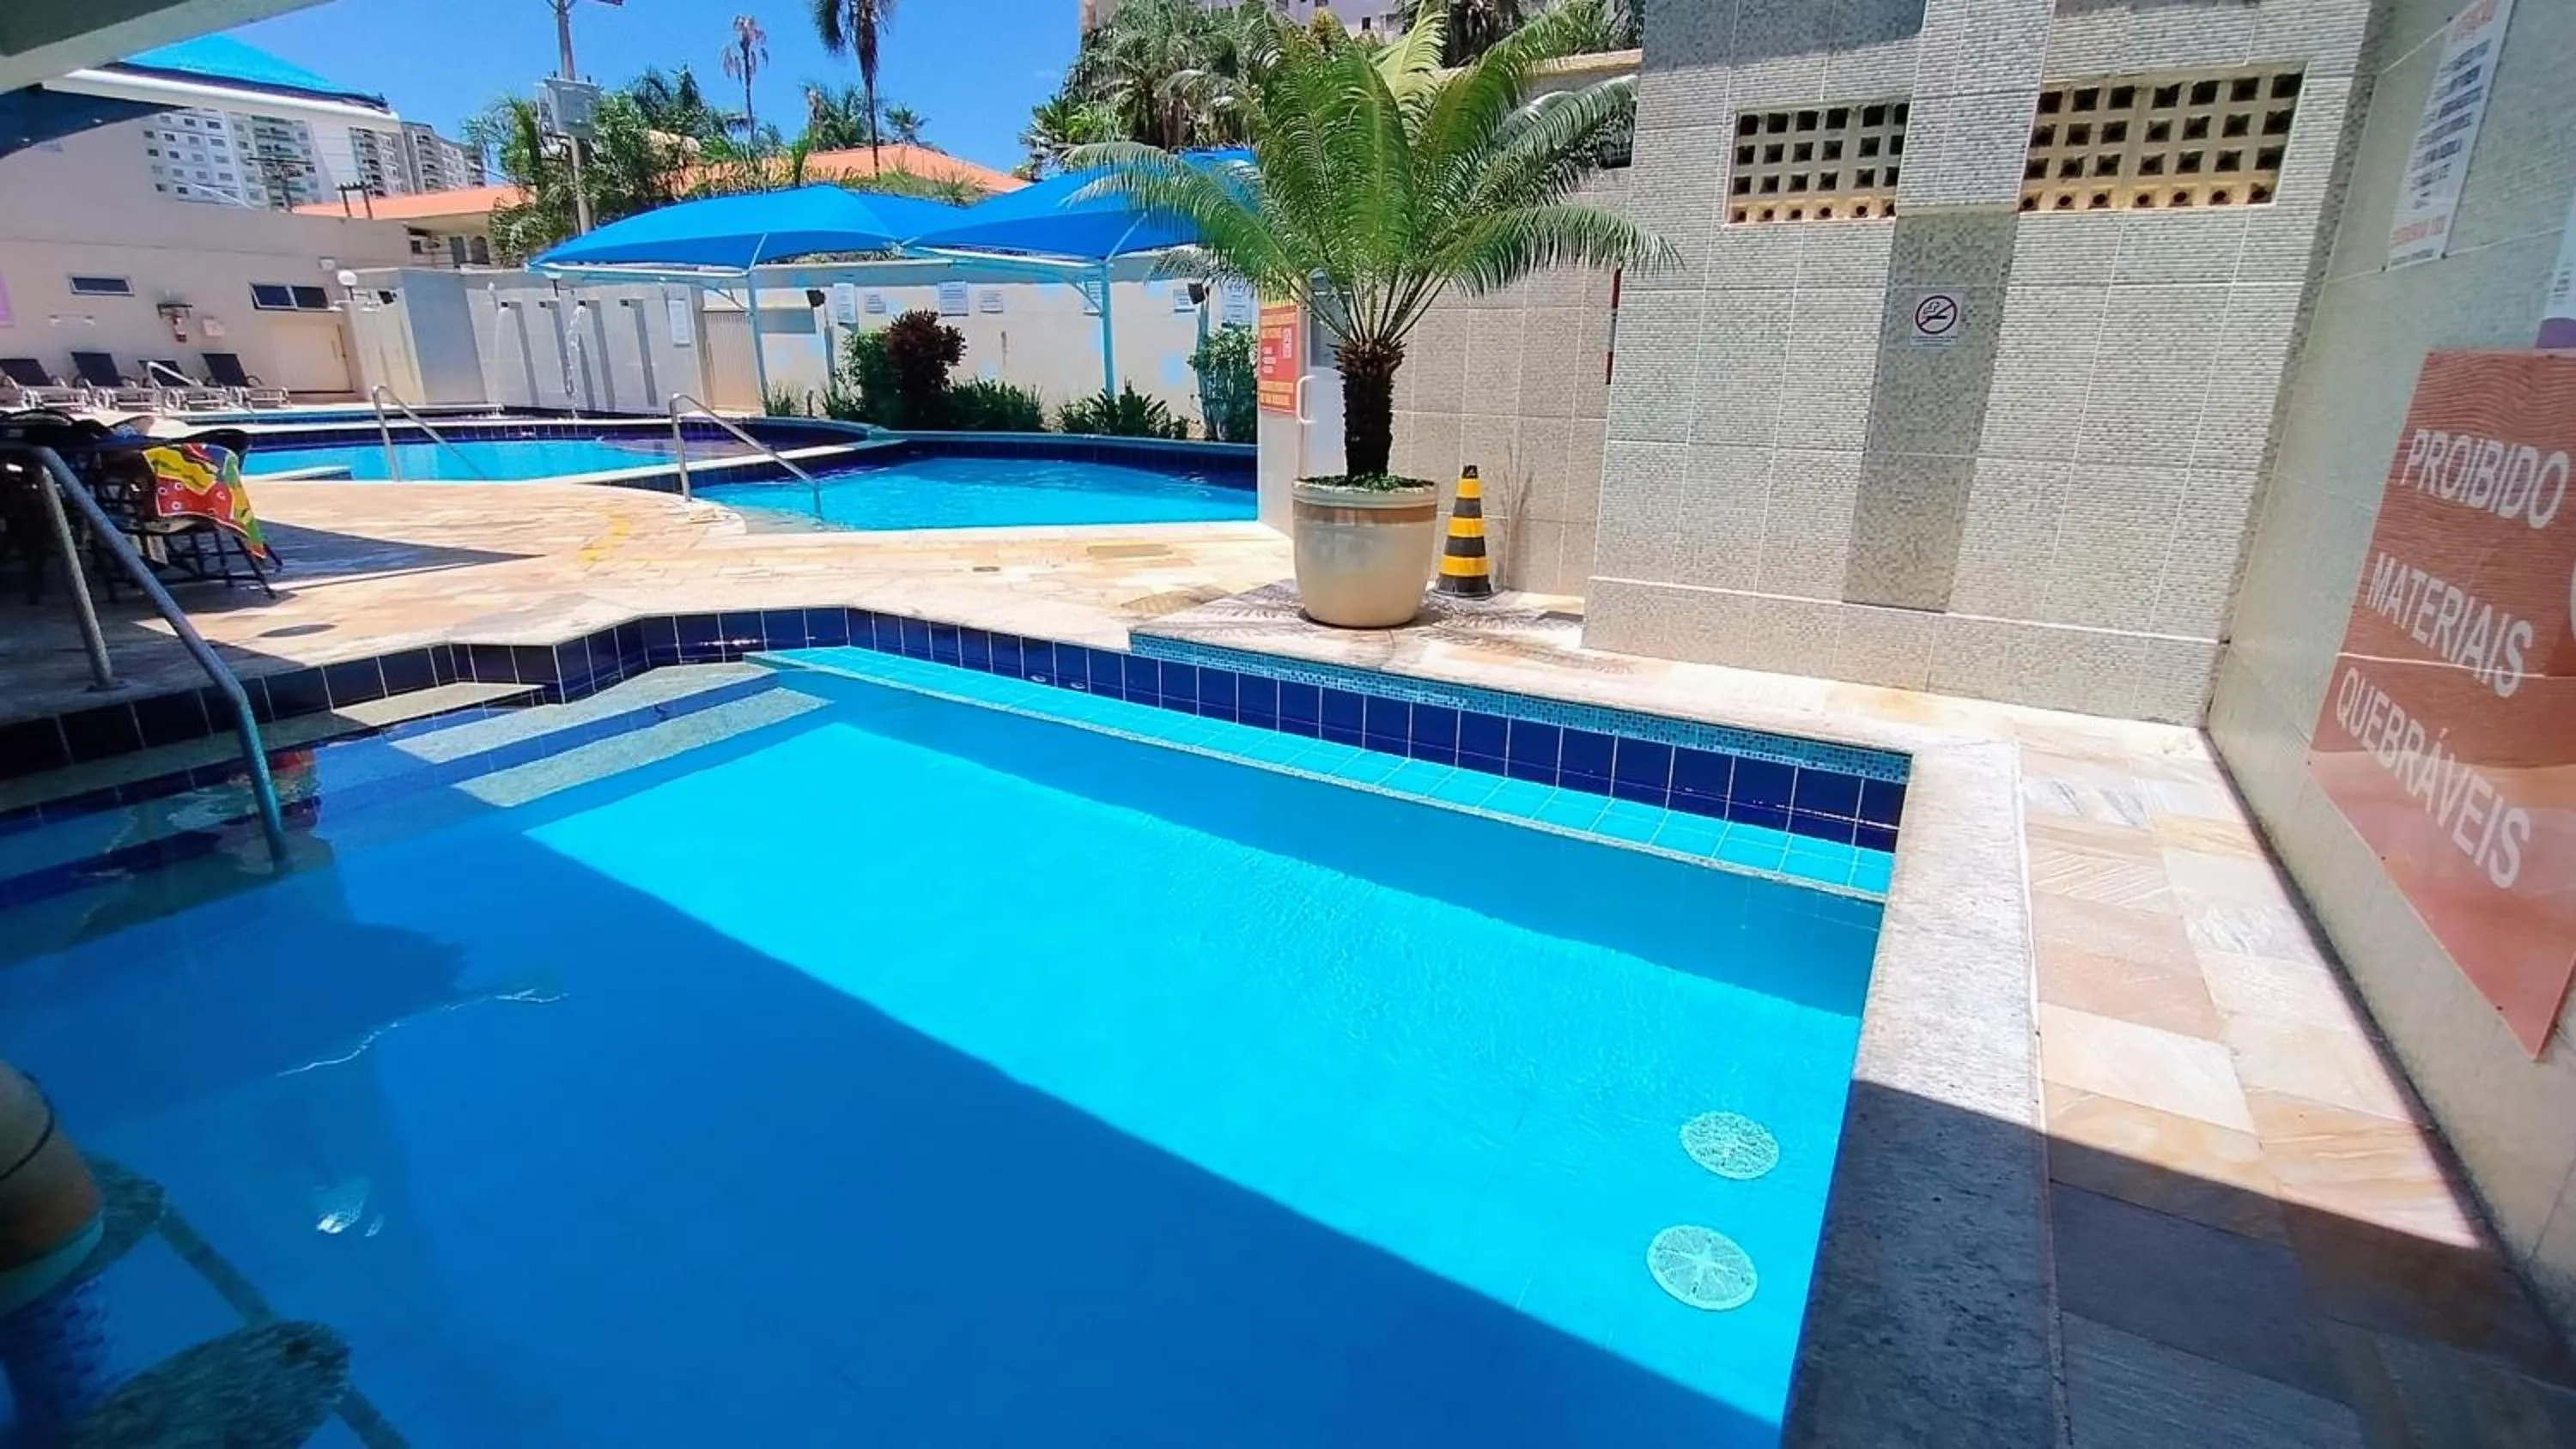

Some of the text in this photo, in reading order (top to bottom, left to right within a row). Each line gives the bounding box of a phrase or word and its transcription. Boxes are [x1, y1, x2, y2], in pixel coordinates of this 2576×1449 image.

[2401, 428, 2570, 530] PROIBIDO
[2366, 552, 2532, 699] MATERIAIS
[2336, 667, 2530, 889] QUEBRÁVEIS
